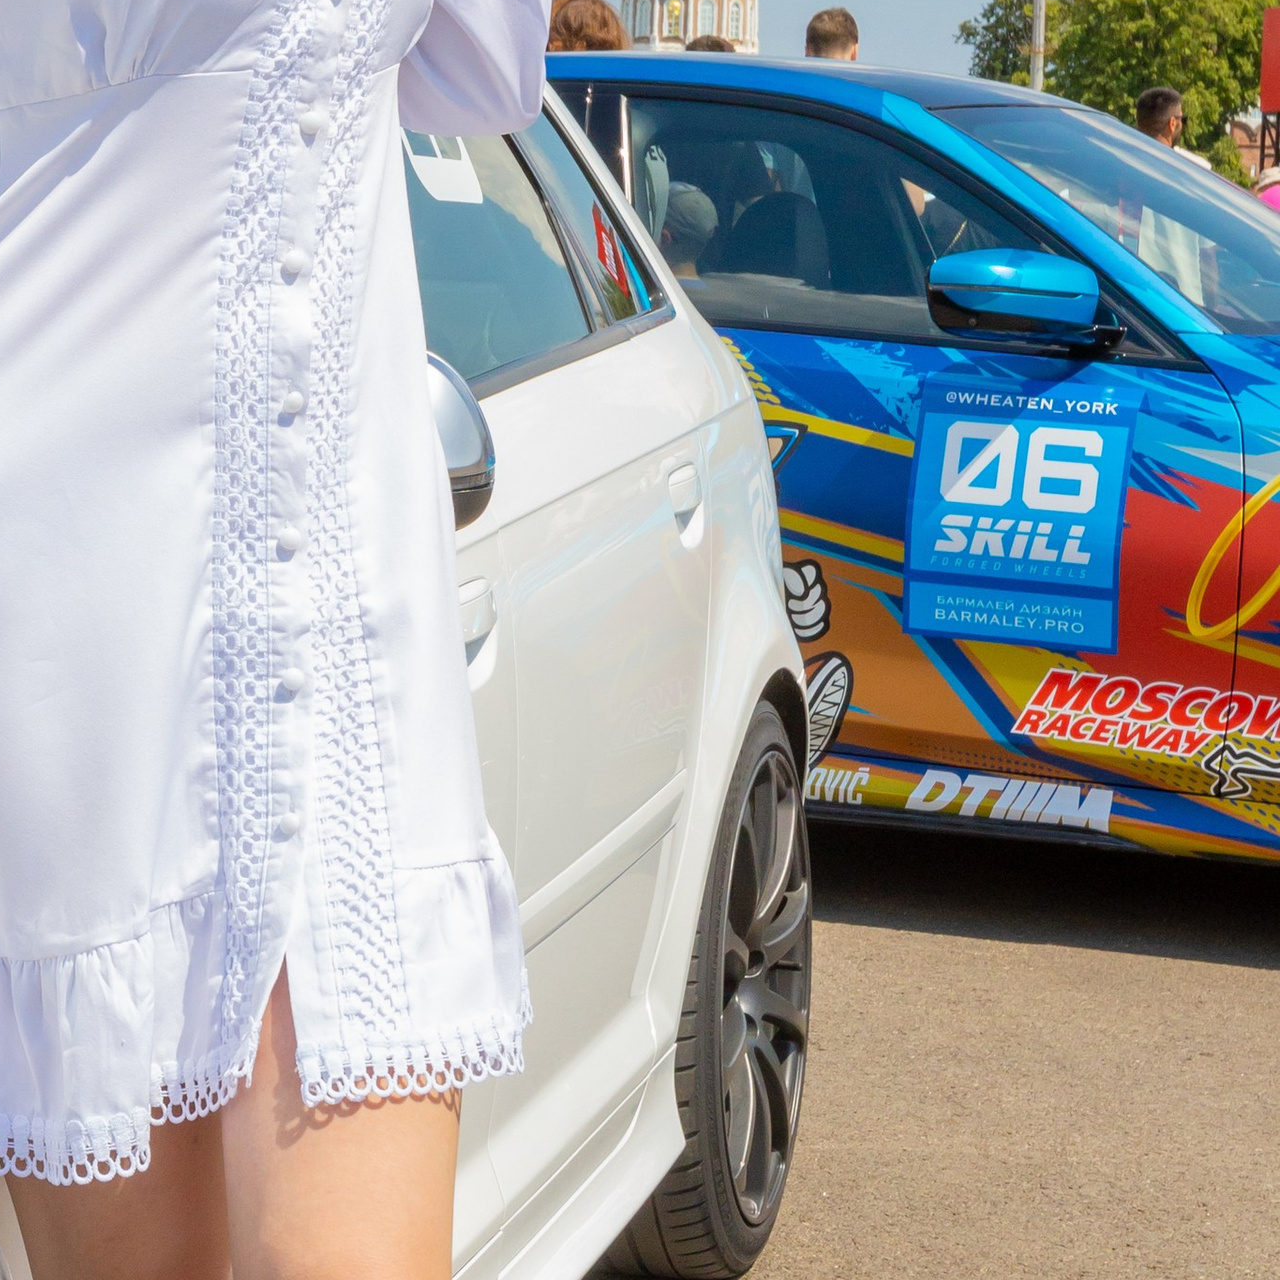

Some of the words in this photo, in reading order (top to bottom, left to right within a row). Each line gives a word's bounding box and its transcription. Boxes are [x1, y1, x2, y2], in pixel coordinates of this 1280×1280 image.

[946, 391, 1119, 416] @WHEATEN_YORK
[939, 420, 1104, 515] 06
[933, 514, 1092, 565] SKILL
[930, 555, 1002, 571] FORGED
[1014, 563, 1088, 579] WHEELS
[936, 594, 1015, 611] БАРМАЛЕЙ
[1019, 600, 1083, 618] ДИЗАЙН
[934, 608, 1085, 634] BARMALEY.PRO
[1010, 707, 1213, 758] RACEWAY
